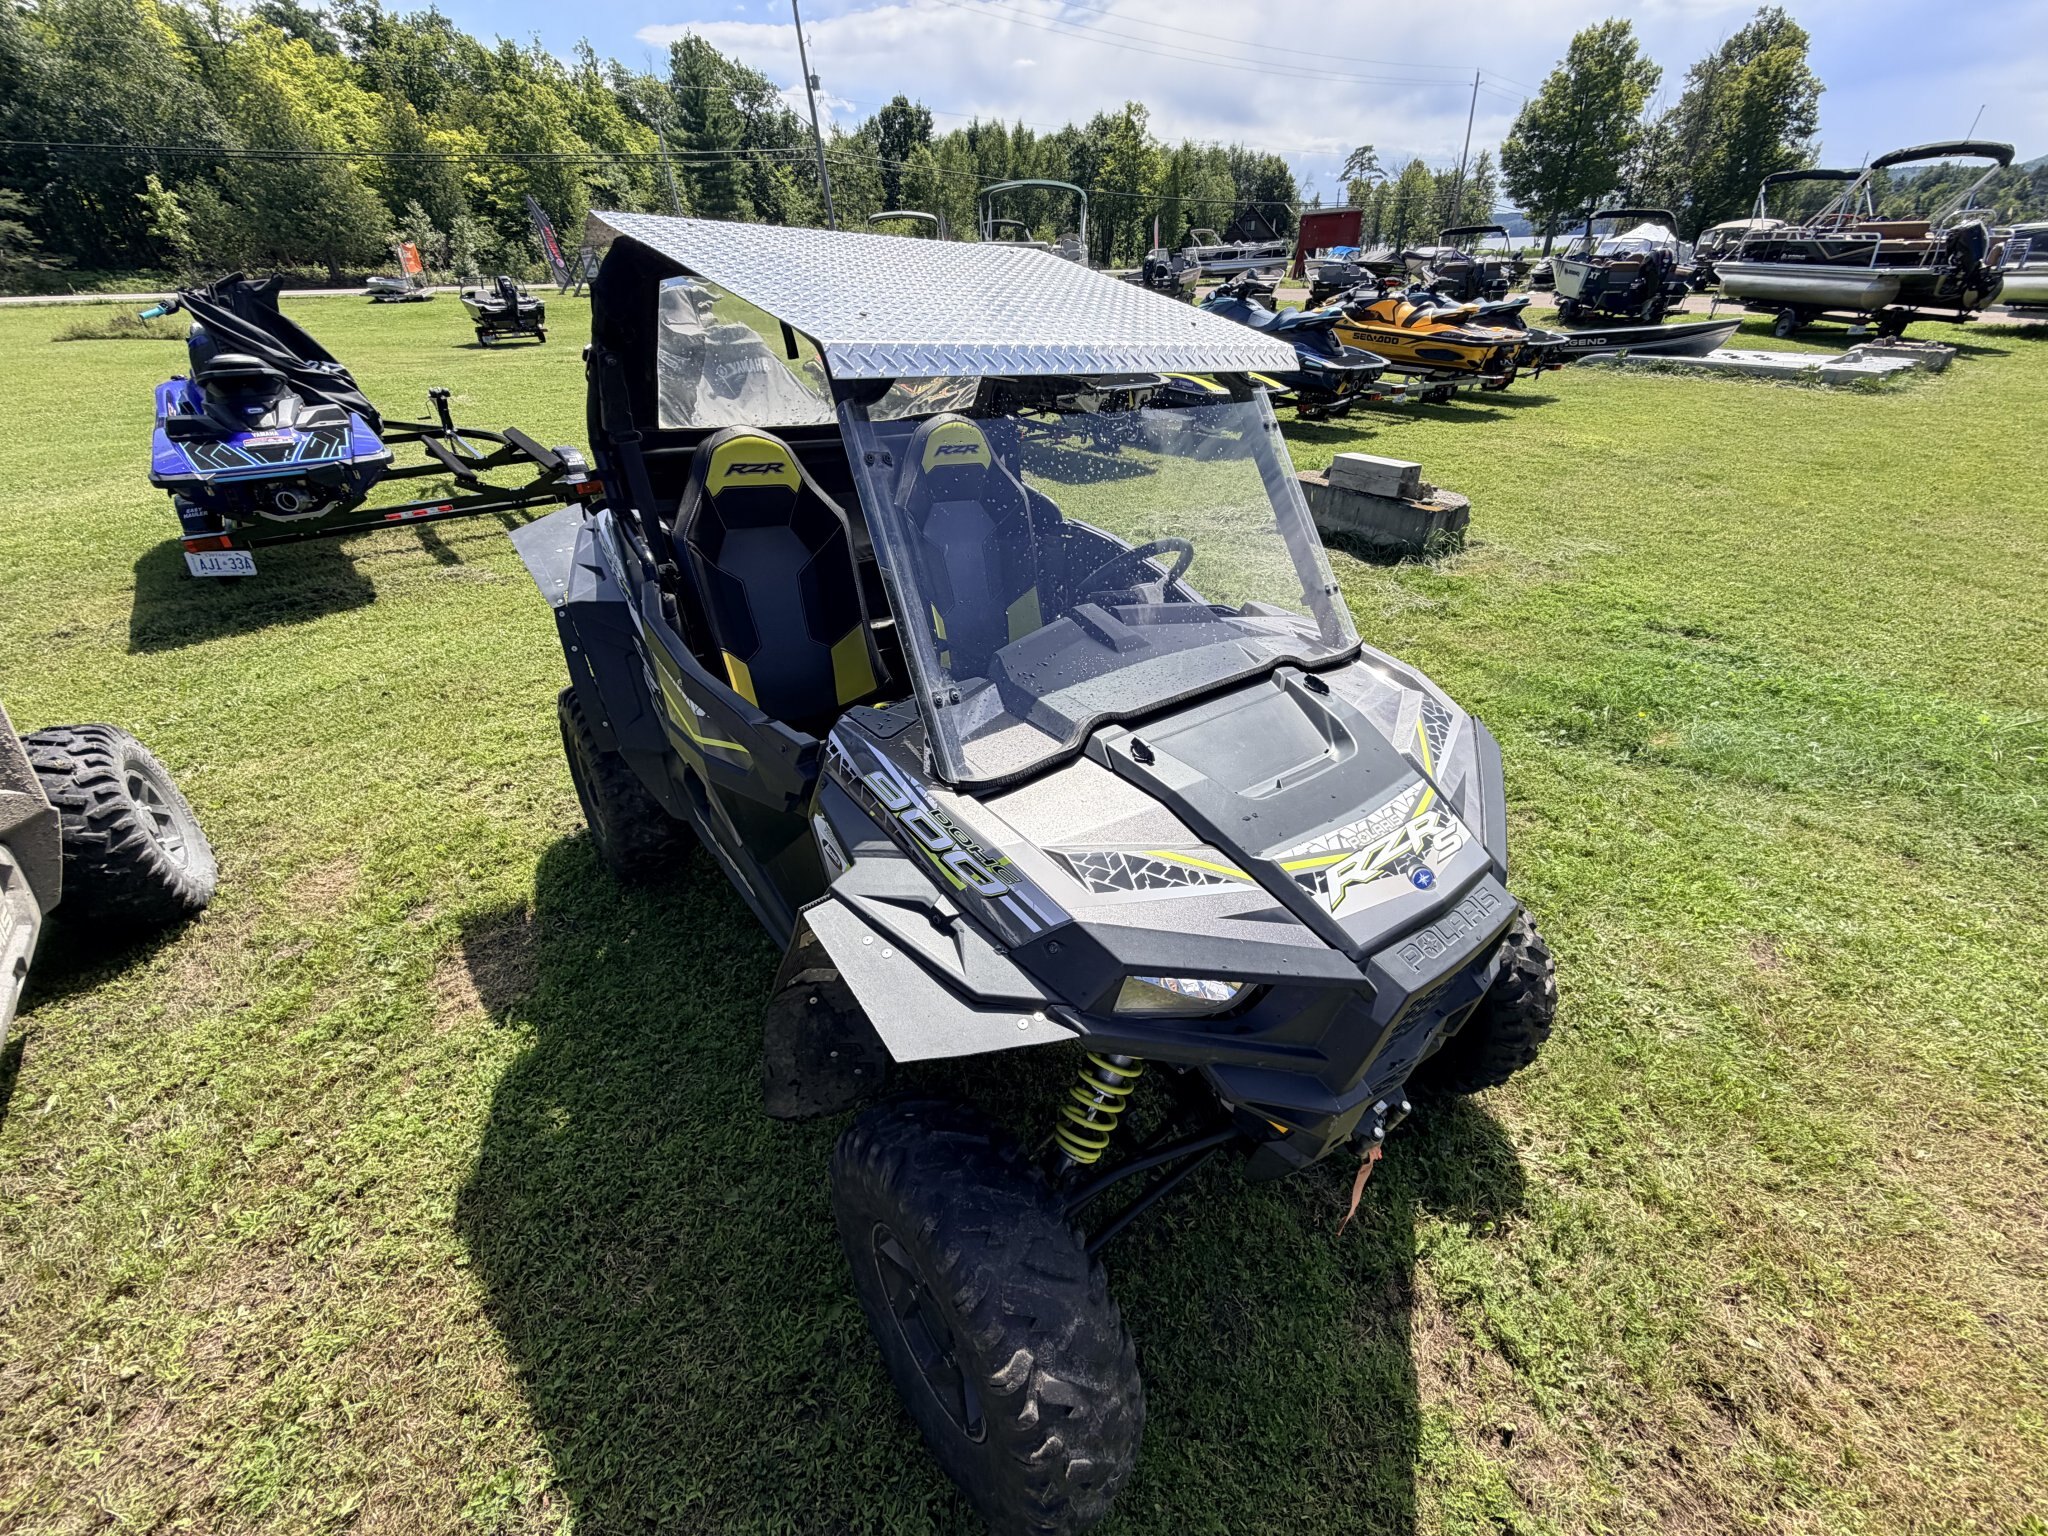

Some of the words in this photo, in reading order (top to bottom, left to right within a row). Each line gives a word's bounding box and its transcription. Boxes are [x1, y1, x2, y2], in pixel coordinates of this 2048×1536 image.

[1588, 271, 1600, 280] XT
[724, 462, 785, 477] RZR
[935, 444, 979, 457] RZR
[862, 770, 1010, 897] 900
[927, 808, 1023, 885] DOHC
[1347, 815, 1402, 850] POLARIS
[1325, 810, 1442, 914] RZR
[1432, 821, 1464, 865] S
[1396, 886, 1502, 975] POLARIS
